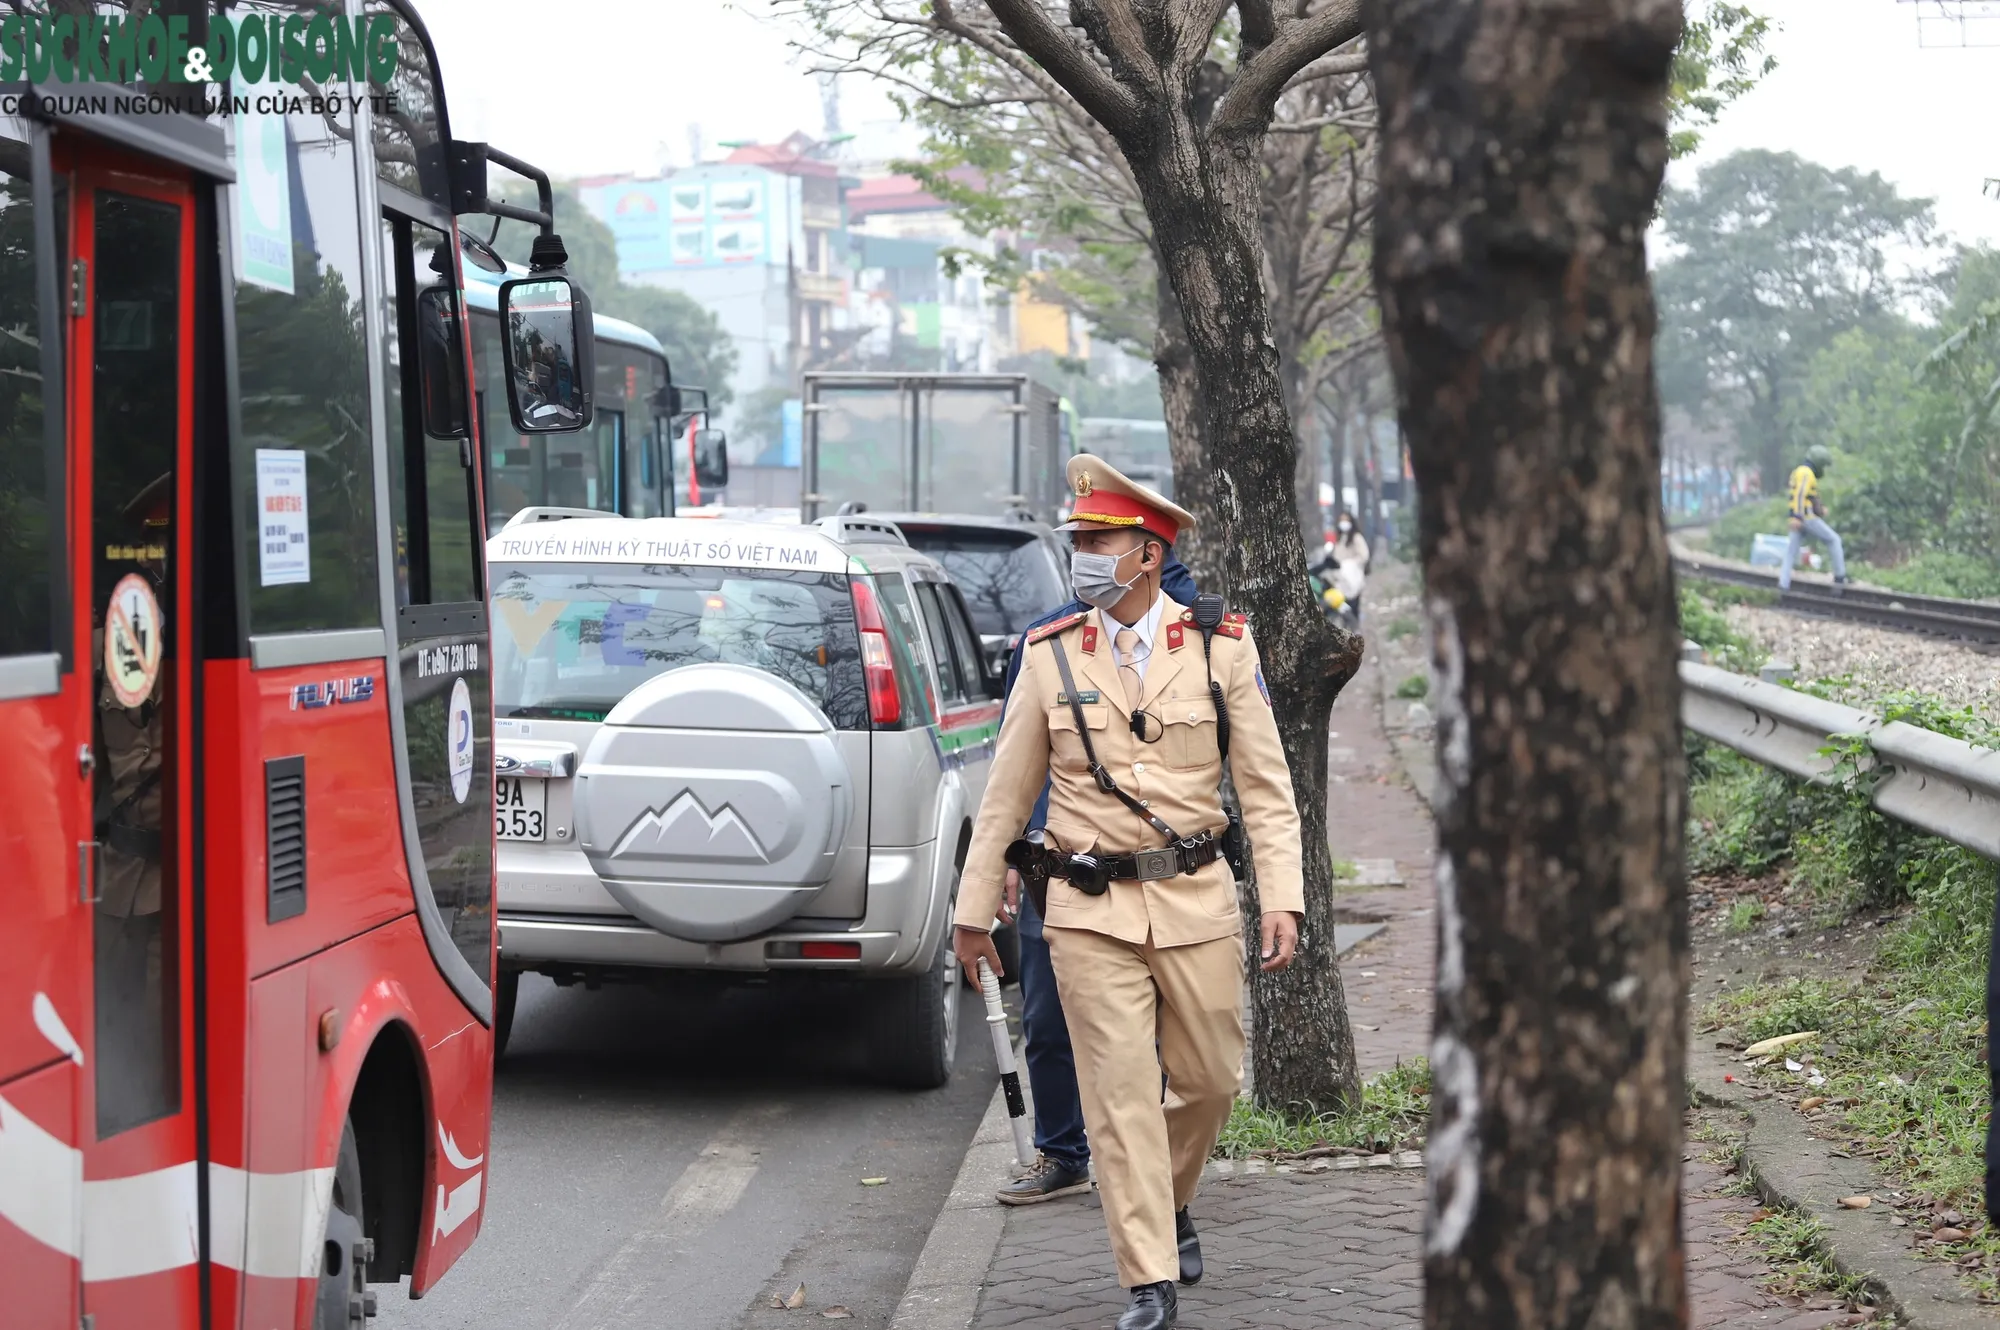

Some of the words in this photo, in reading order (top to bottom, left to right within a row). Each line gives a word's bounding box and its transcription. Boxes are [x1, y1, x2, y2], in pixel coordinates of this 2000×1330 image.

[572, 537, 612, 556] HÌNH
[647, 538, 702, 562] THUẬT
[707, 537, 732, 560] SỐ
[737, 542, 774, 565] VIỆT
[779, 547, 818, 566] NAM
[451, 644, 463, 672] 238
[465, 643, 478, 670] 199
